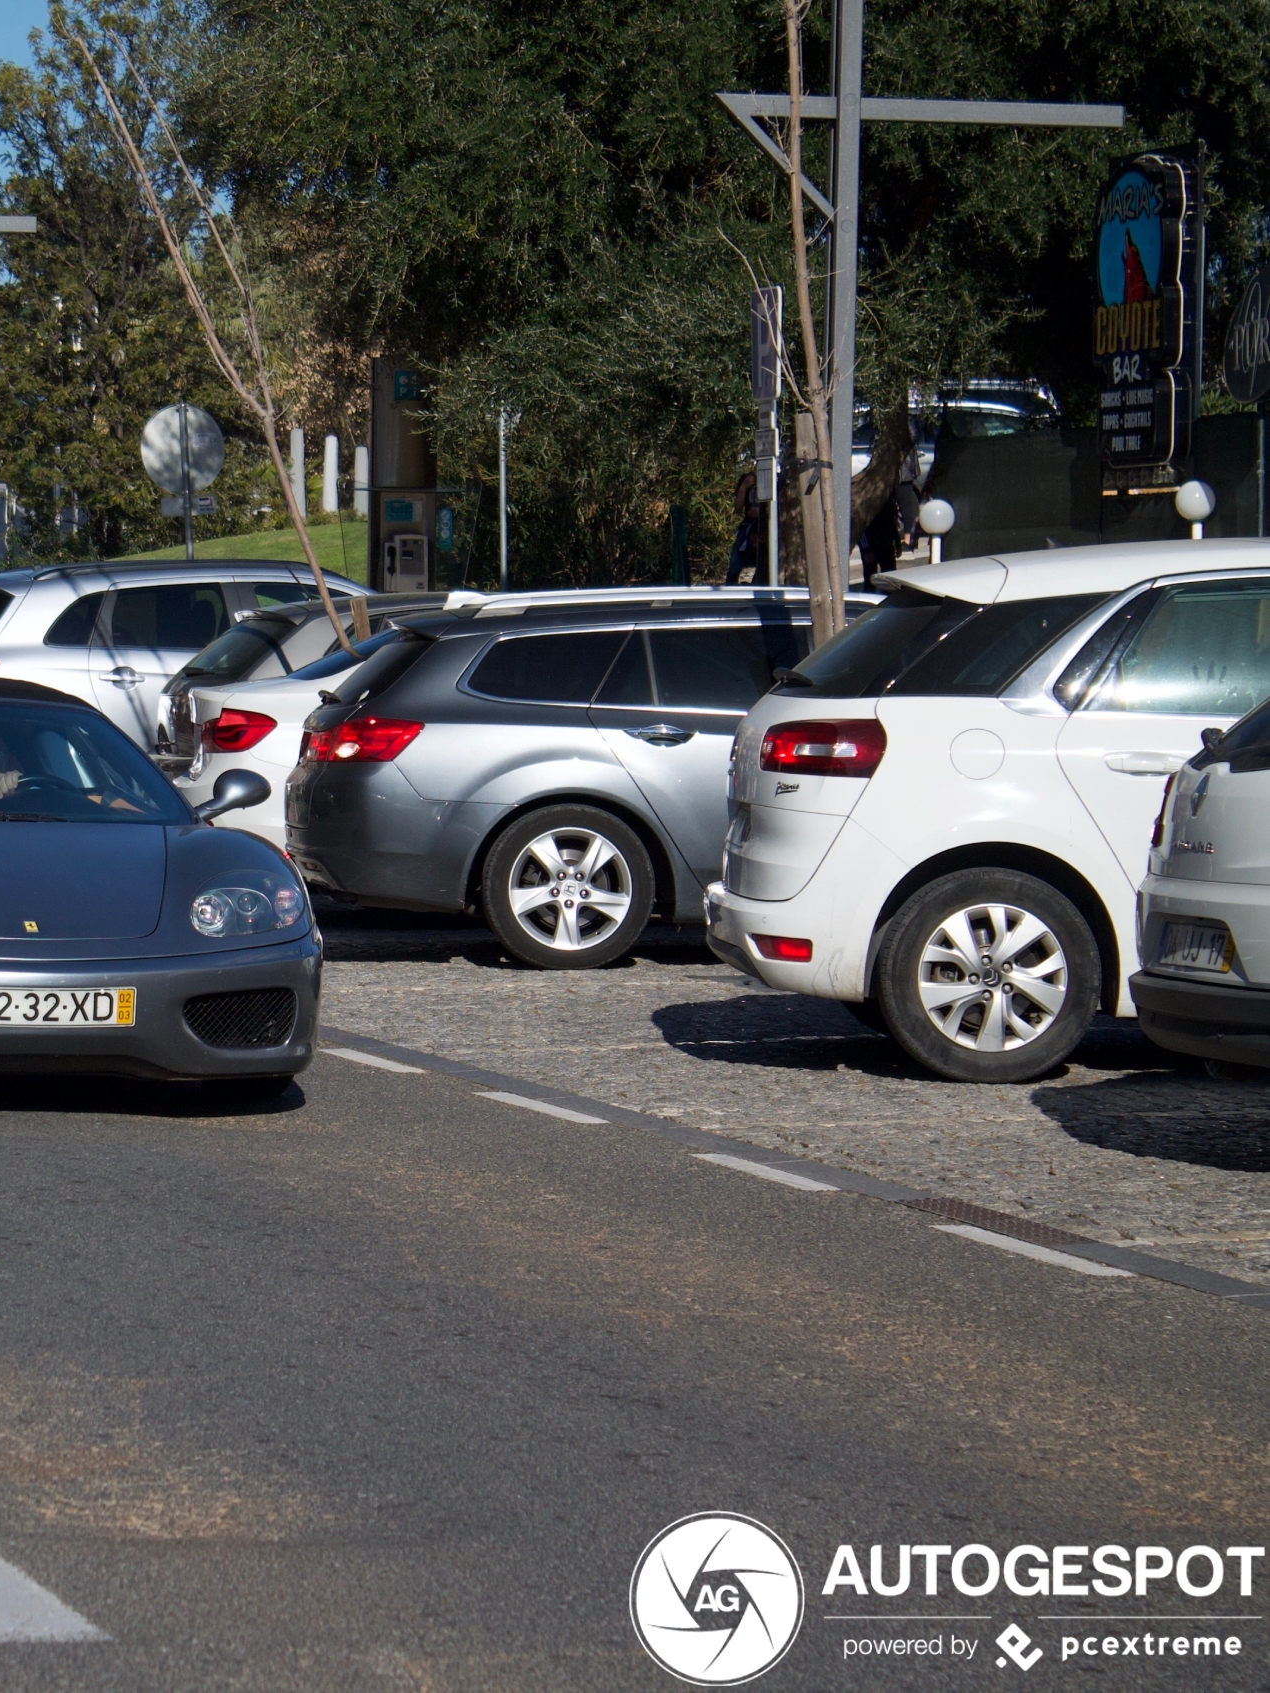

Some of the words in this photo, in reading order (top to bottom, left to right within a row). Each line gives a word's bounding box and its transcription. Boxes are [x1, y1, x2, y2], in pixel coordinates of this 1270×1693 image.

[1097, 183, 1164, 226] MARIA'S
[1096, 302, 1161, 355] COYOTE
[1112, 354, 1142, 385] BAR
[1101, 390, 1121, 408] SNACKS
[1102, 413, 1120, 430] TAPAS
[1124, 411, 1152, 428] COCKTAILS
[1112, 436, 1125, 452] POOL
[1125, 434, 1141, 451] TABLE
[119, 993, 132, 1003] 02
[118, 1010, 131, 1020] 03
